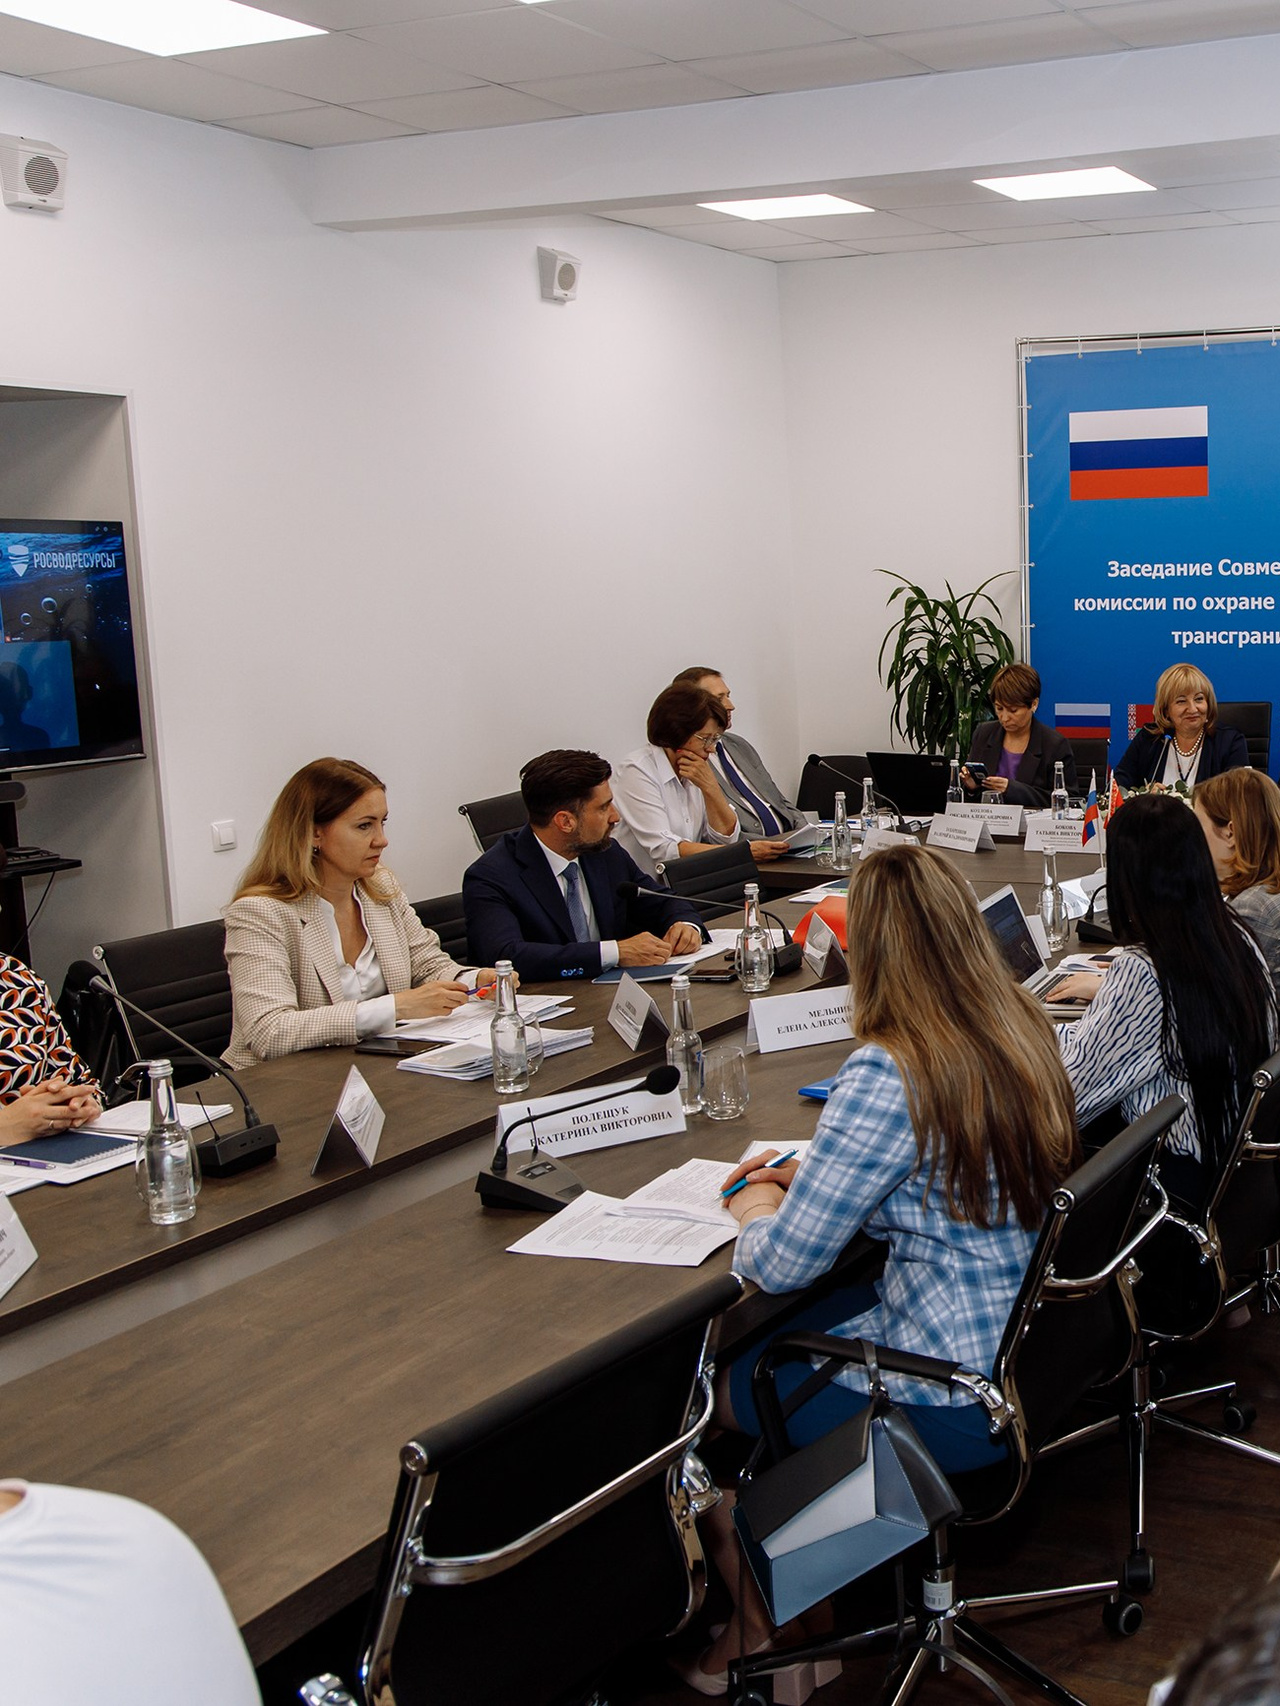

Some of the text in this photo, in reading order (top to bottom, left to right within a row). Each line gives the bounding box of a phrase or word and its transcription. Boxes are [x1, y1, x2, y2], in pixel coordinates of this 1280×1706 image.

[33, 552, 116, 570] РОСВОДРЕСУРСЫ
[1107, 560, 1213, 580] Заседание
[1074, 597, 1167, 611] комиссии
[1173, 597, 1197, 611] по
[1202, 596, 1275, 614] охране
[777, 1023, 808, 1035] ЕЛЕНА
[571, 1106, 630, 1126] ПОЛЕЩУК
[530, 1111, 673, 1147] ЕКАТЕРИНА ВИКТОРОВНА
